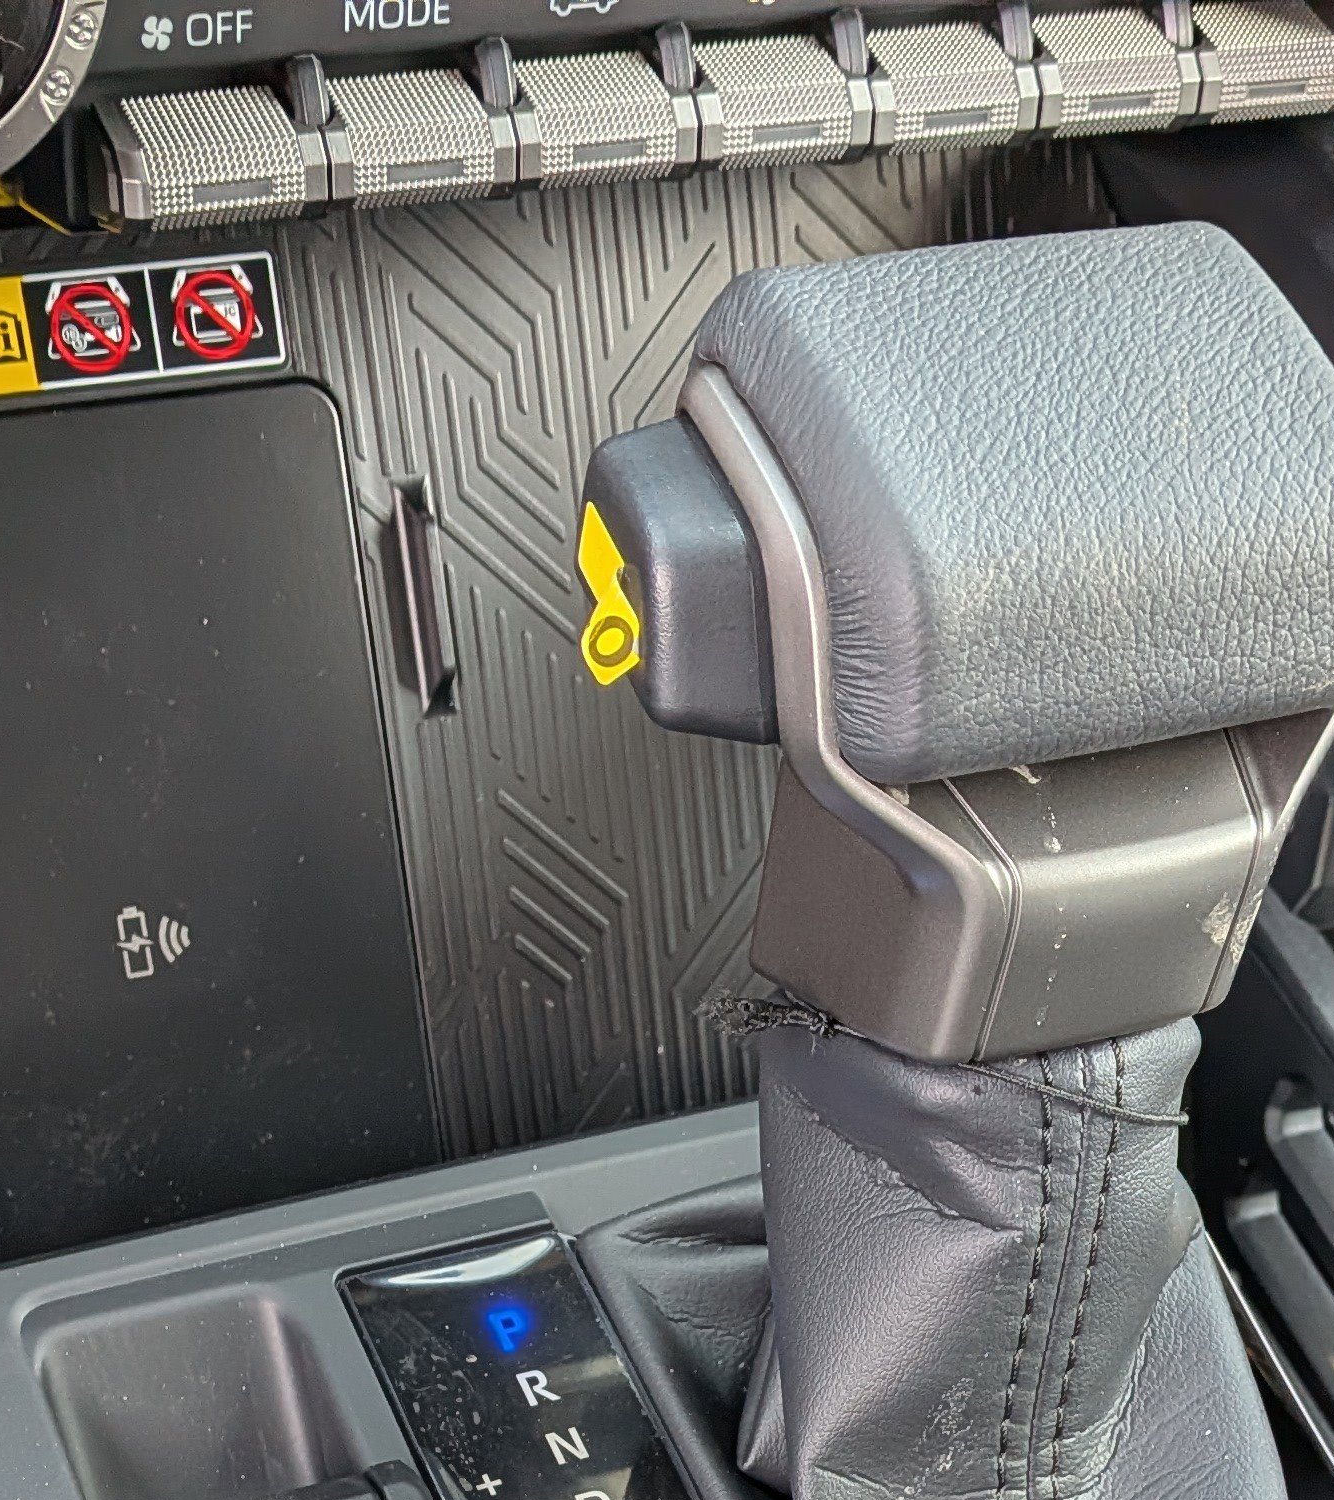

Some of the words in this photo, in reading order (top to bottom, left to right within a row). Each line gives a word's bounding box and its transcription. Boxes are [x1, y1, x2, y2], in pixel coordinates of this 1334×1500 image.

[185, 9, 254, 47] OFF
[344, 0, 451, 33] MODE
[488, 1308, 525, 1353] P
[515, 1368, 561, 1408] R
[544, 1426, 590, 1467] N
